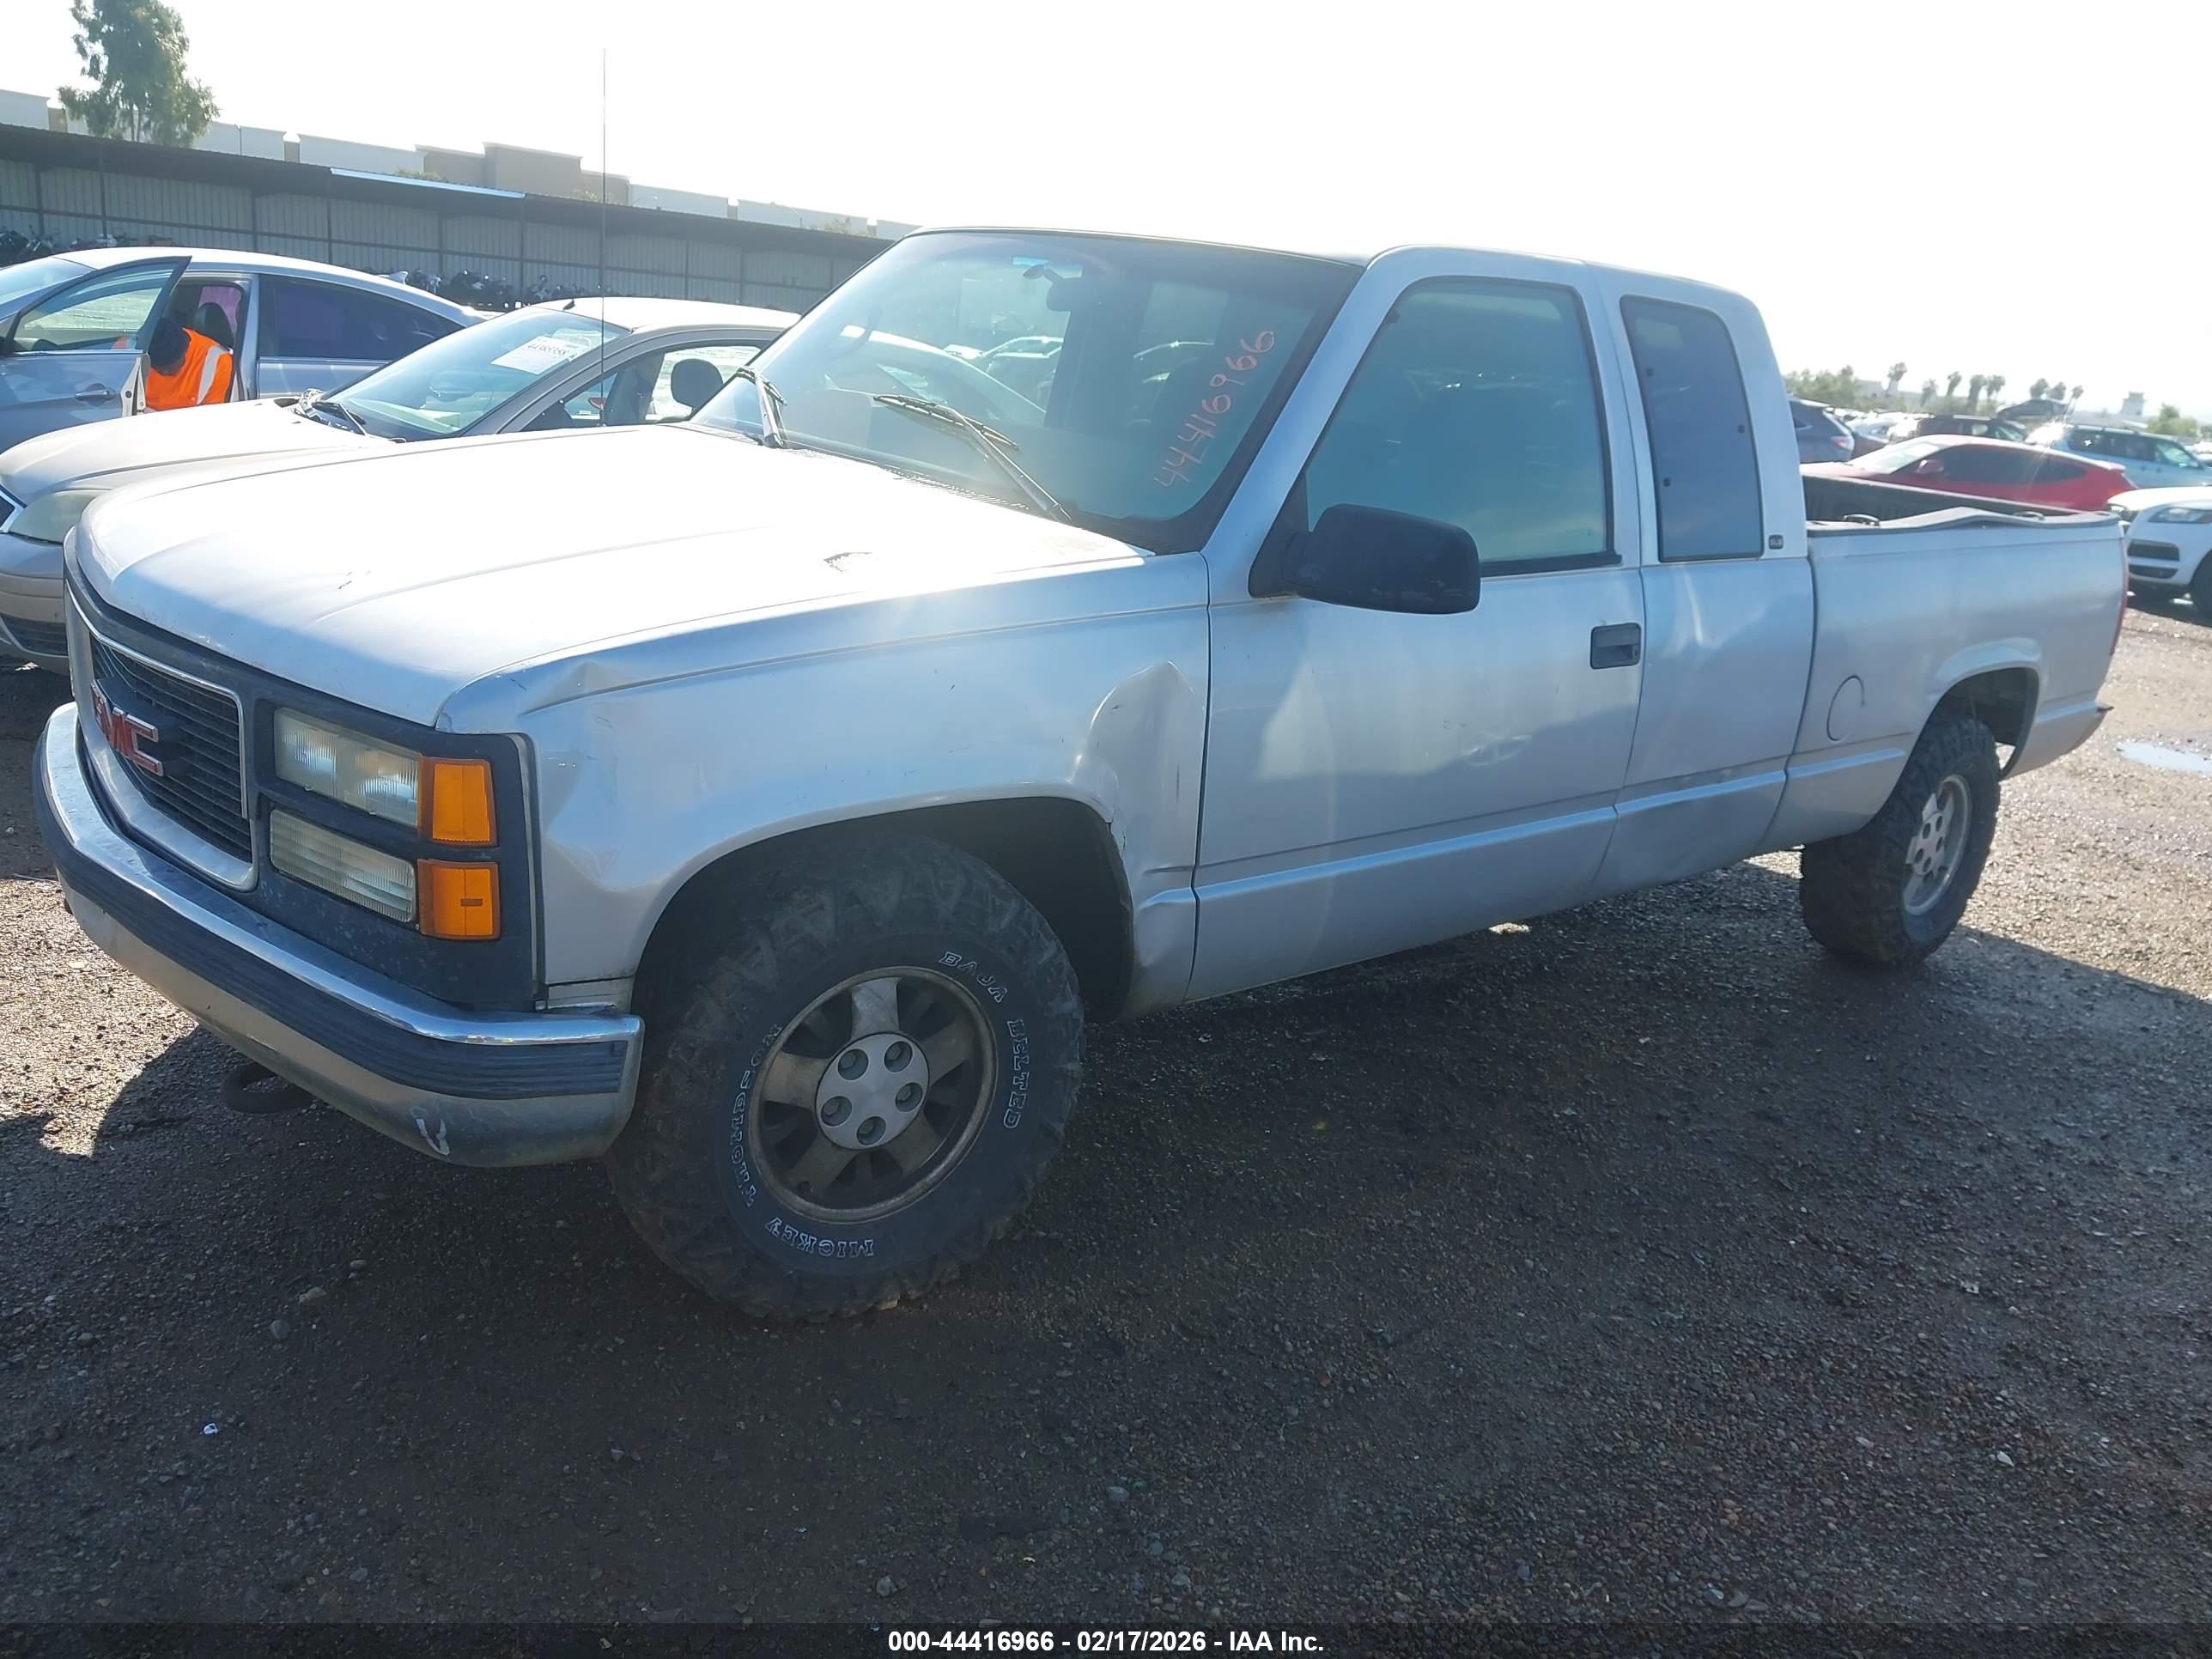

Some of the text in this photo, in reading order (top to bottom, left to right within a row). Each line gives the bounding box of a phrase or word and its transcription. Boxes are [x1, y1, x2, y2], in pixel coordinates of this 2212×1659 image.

[1153, 330, 1275, 488] 44416966
[939, 951, 1030, 1129] BAJA BELTED
[729, 1023, 874, 1258] MICKEY THOMPSON
